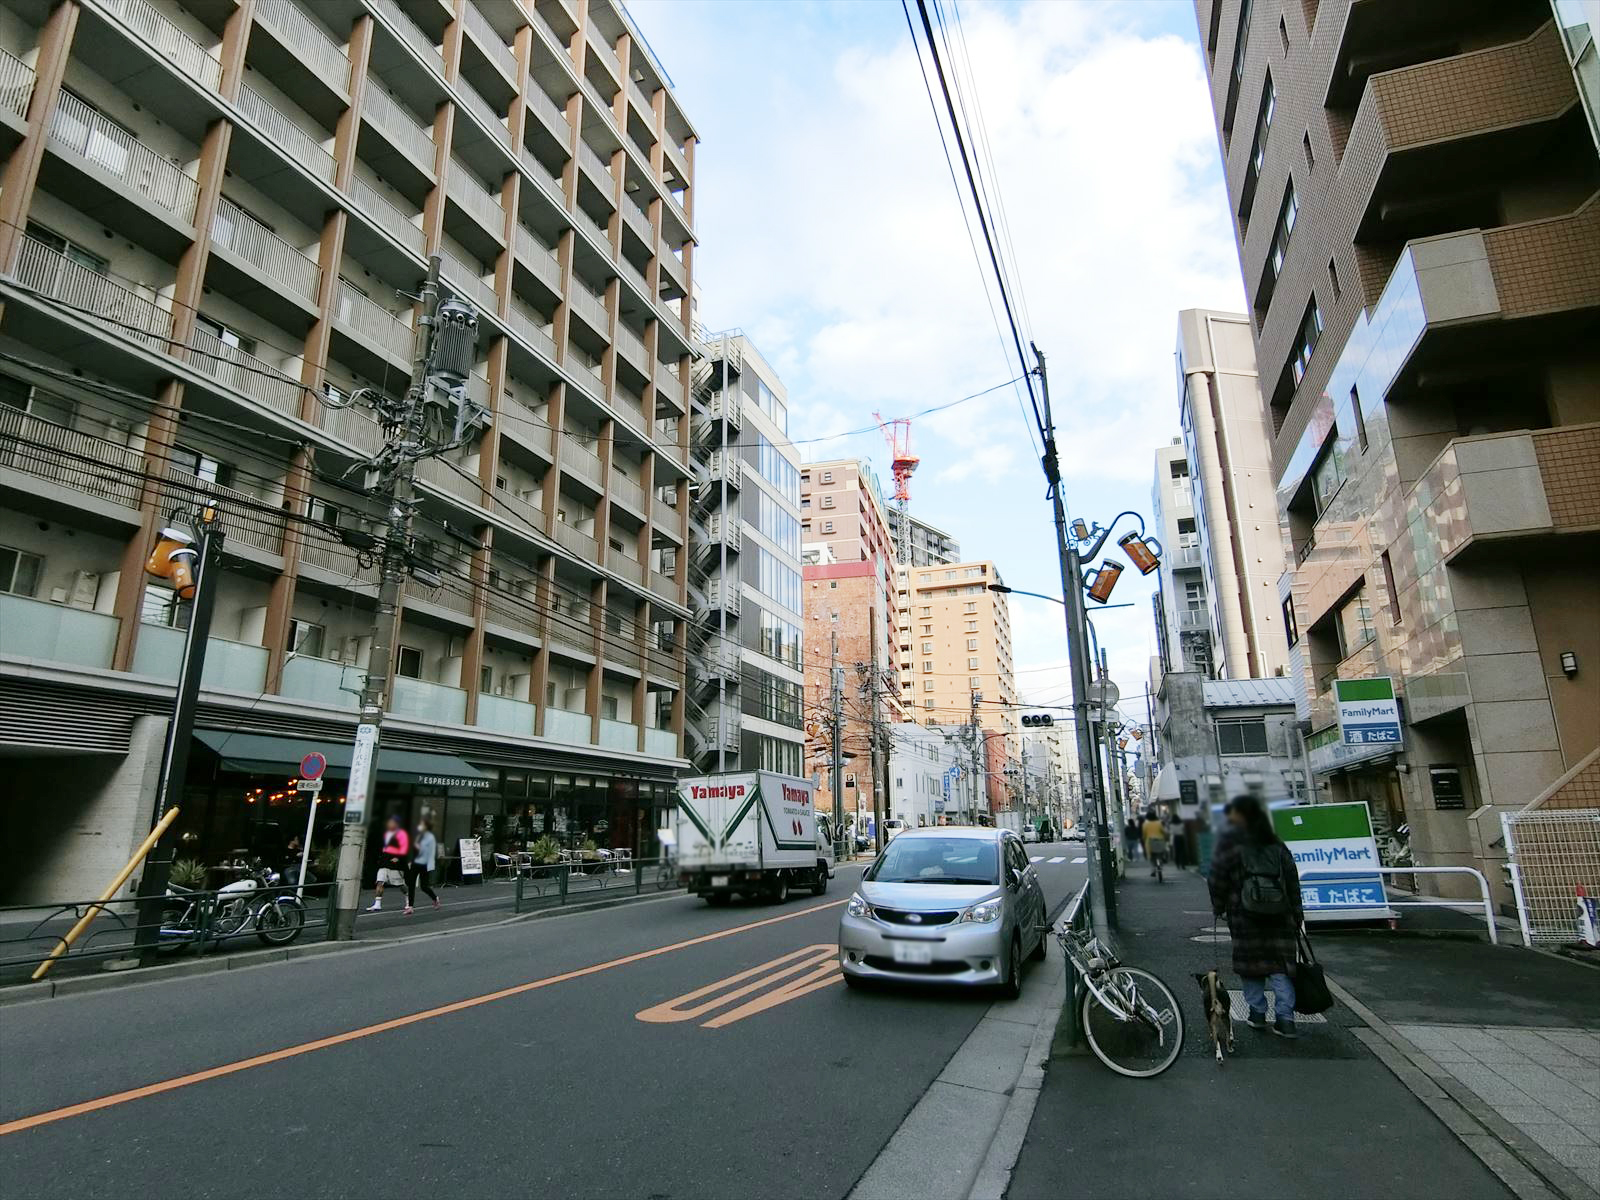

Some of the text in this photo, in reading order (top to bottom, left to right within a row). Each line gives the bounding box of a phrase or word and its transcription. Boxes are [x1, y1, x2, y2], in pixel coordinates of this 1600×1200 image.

[1342, 707, 1394, 718] FamilyMart
[1348, 730, 1396, 743] 酒 たばこ
[423, 776, 460, 786] ESPRESSO
[690, 784, 745, 800] Yamaya
[782, 784, 810, 806] Yamaya
[1291, 847, 1371, 864] amilyMart
[1328, 888, 1376, 904] たばこ
